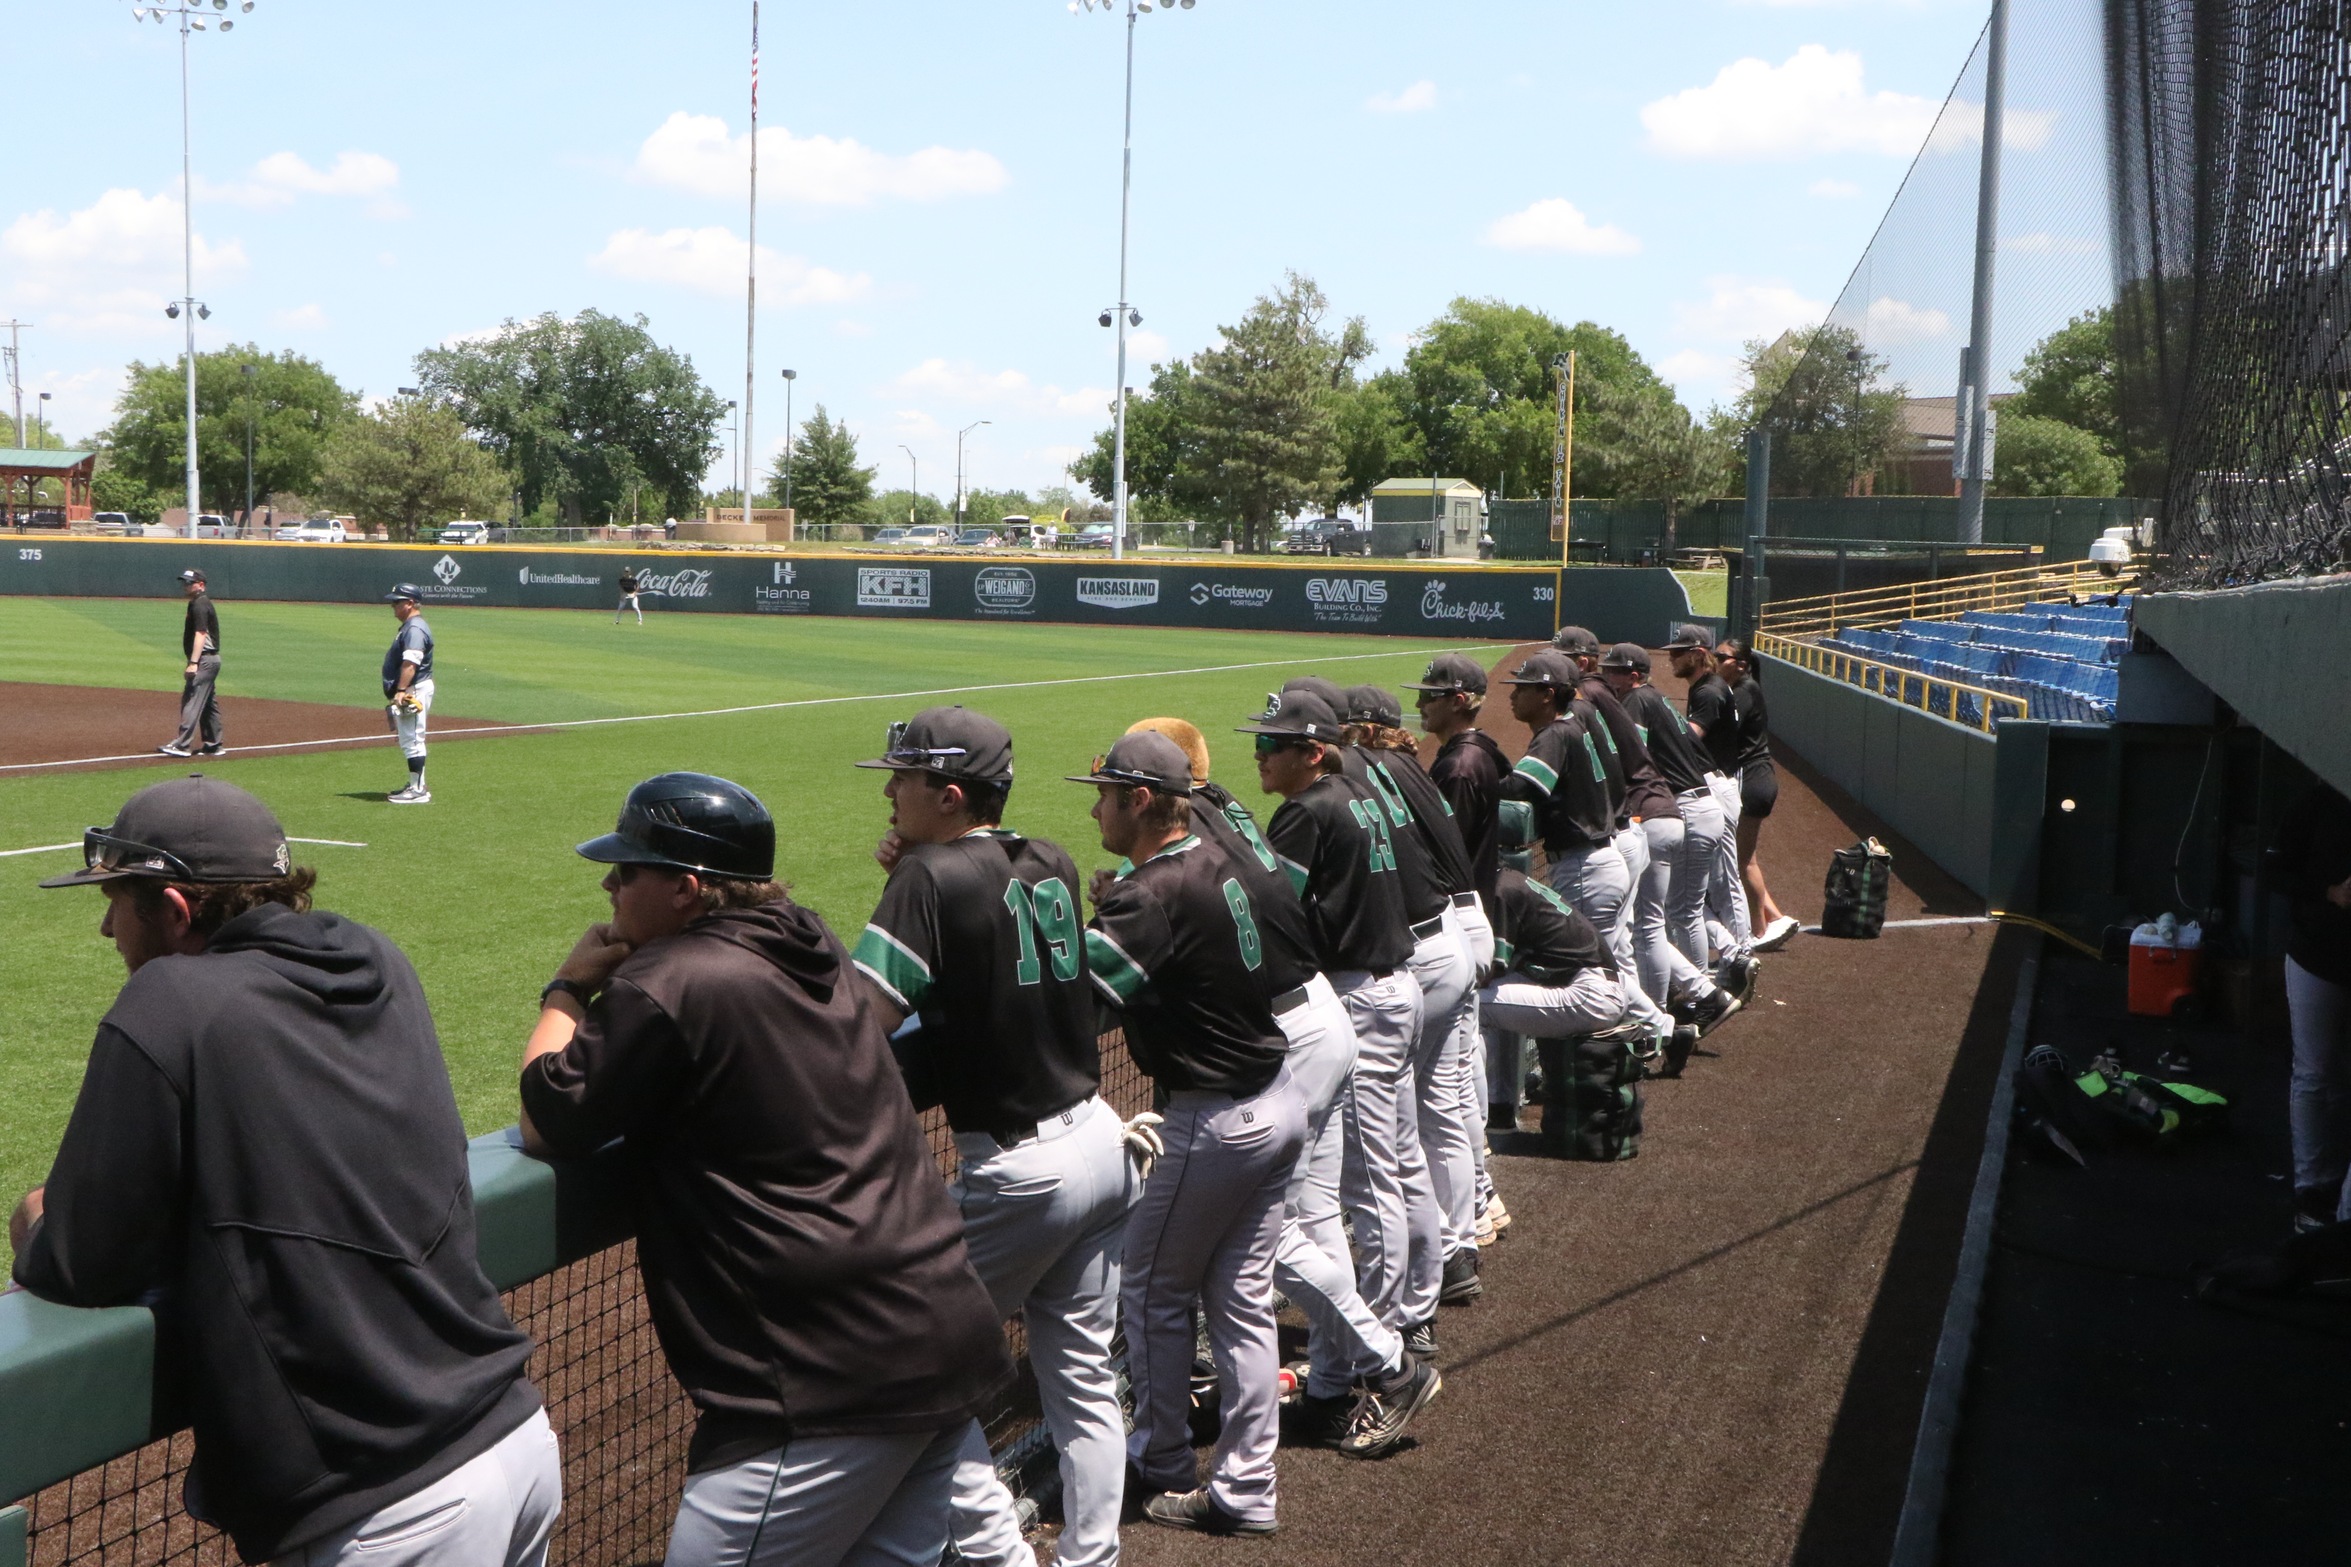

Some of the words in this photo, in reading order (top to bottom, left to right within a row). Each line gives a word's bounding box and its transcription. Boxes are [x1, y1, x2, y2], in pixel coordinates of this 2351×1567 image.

[19, 548, 42, 561] 375
[530, 573, 600, 585] UnitedHealthcare
[635, 567, 713, 598] Coca-Cola
[861, 576, 927, 597] KFH
[984, 579, 1025, 596] WEIGAND
[433, 585, 488, 594] CONNECTIONS
[756, 586, 810, 600] Hanna
[1080, 580, 1156, 597] KANSASLAND
[1211, 583, 1273, 603] Gateway
[1305, 578, 1388, 604] EVANS
[1533, 586, 1555, 601] 330
[1229, 599, 1264, 607] MORTGAGE
[1313, 602, 1349, 612] BUILDING
[1366, 604, 1383, 613] INC.
[1421, 588, 1505, 623] Chick-fil-A
[1349, 798, 1397, 873] 23
[1003, 876, 1080, 986] 19
[1222, 877, 1262, 972] 8
